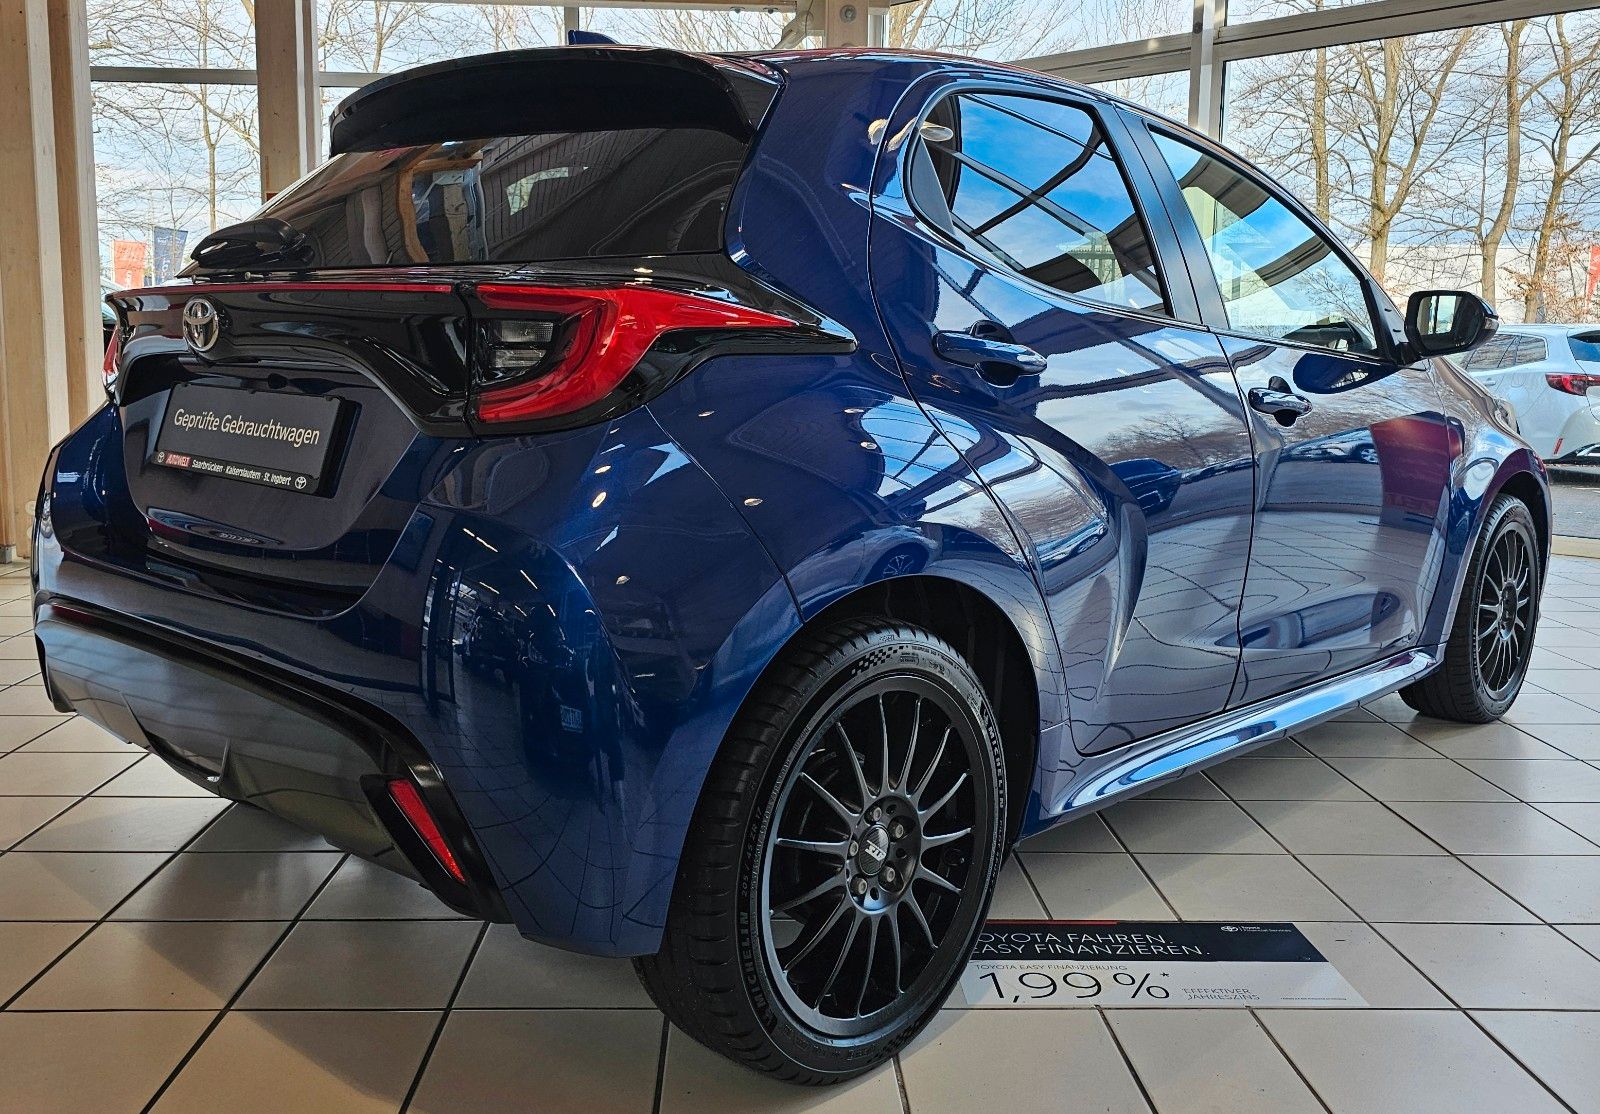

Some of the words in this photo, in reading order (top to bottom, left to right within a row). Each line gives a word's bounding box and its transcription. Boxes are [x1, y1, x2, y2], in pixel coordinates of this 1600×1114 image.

[174, 408, 220, 431] Geprüfte
[221, 414, 320, 448] Gebrauchtwagen
[978, 932, 1062, 943] OYOTA
[1066, 933, 1174, 944] FAHREN.
[1034, 944, 1211, 955] FINANZIEREN.
[979, 972, 1102, 1003] 1,99
